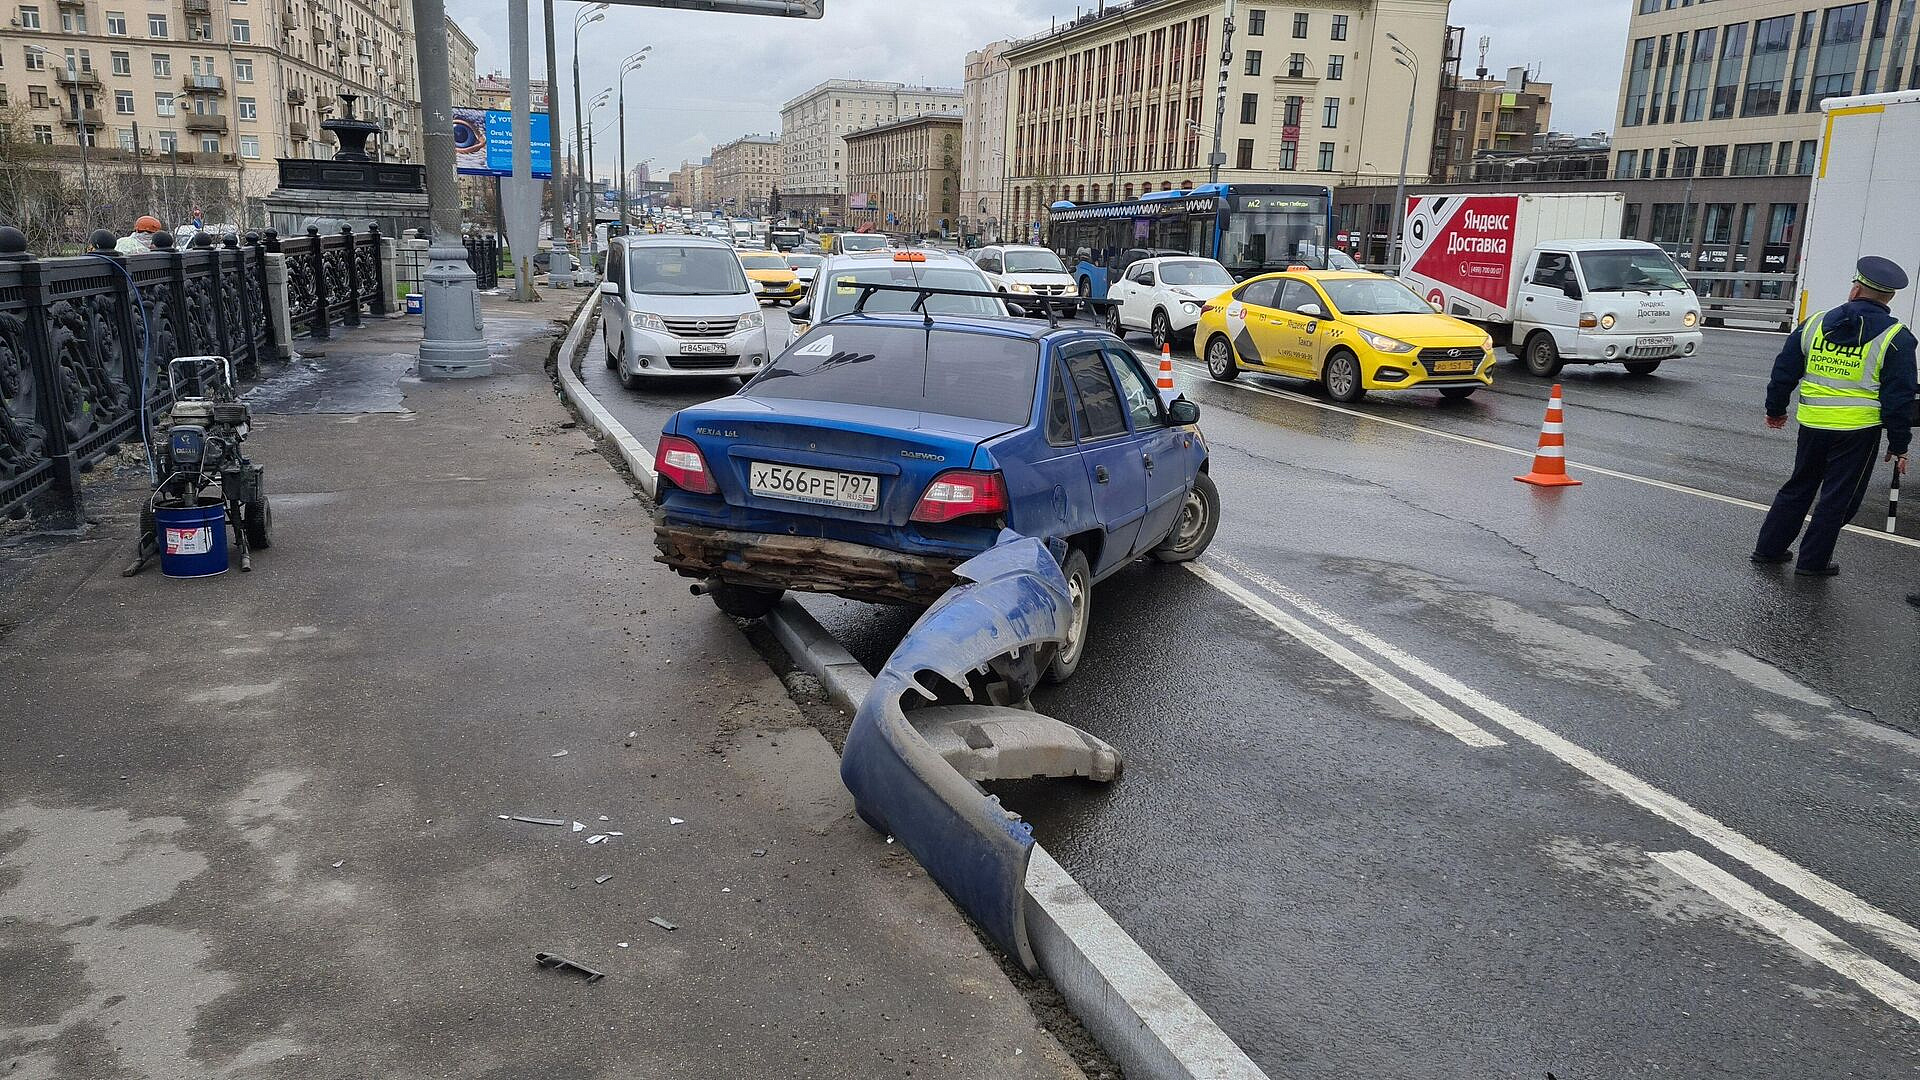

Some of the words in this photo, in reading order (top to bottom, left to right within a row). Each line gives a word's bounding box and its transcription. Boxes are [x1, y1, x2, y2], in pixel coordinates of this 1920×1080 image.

[1464, 210, 1510, 232] Яндекс
[1447, 232, 1506, 254] Доставка
[1637, 309, 1671, 318] Доставка
[1813, 337, 1863, 359] ЦОДД
[1810, 354, 1860, 369] ДОРОЖНЫЙ
[1814, 364, 1851, 376] ПАТРУЛЬ
[696, 427, 721, 437] NEXIA
[900, 450, 945, 462] DAEWOO
[757, 467, 835, 497] Х566РЕ
[840, 474, 872, 495] 797
[847, 492, 863, 502] RUS
